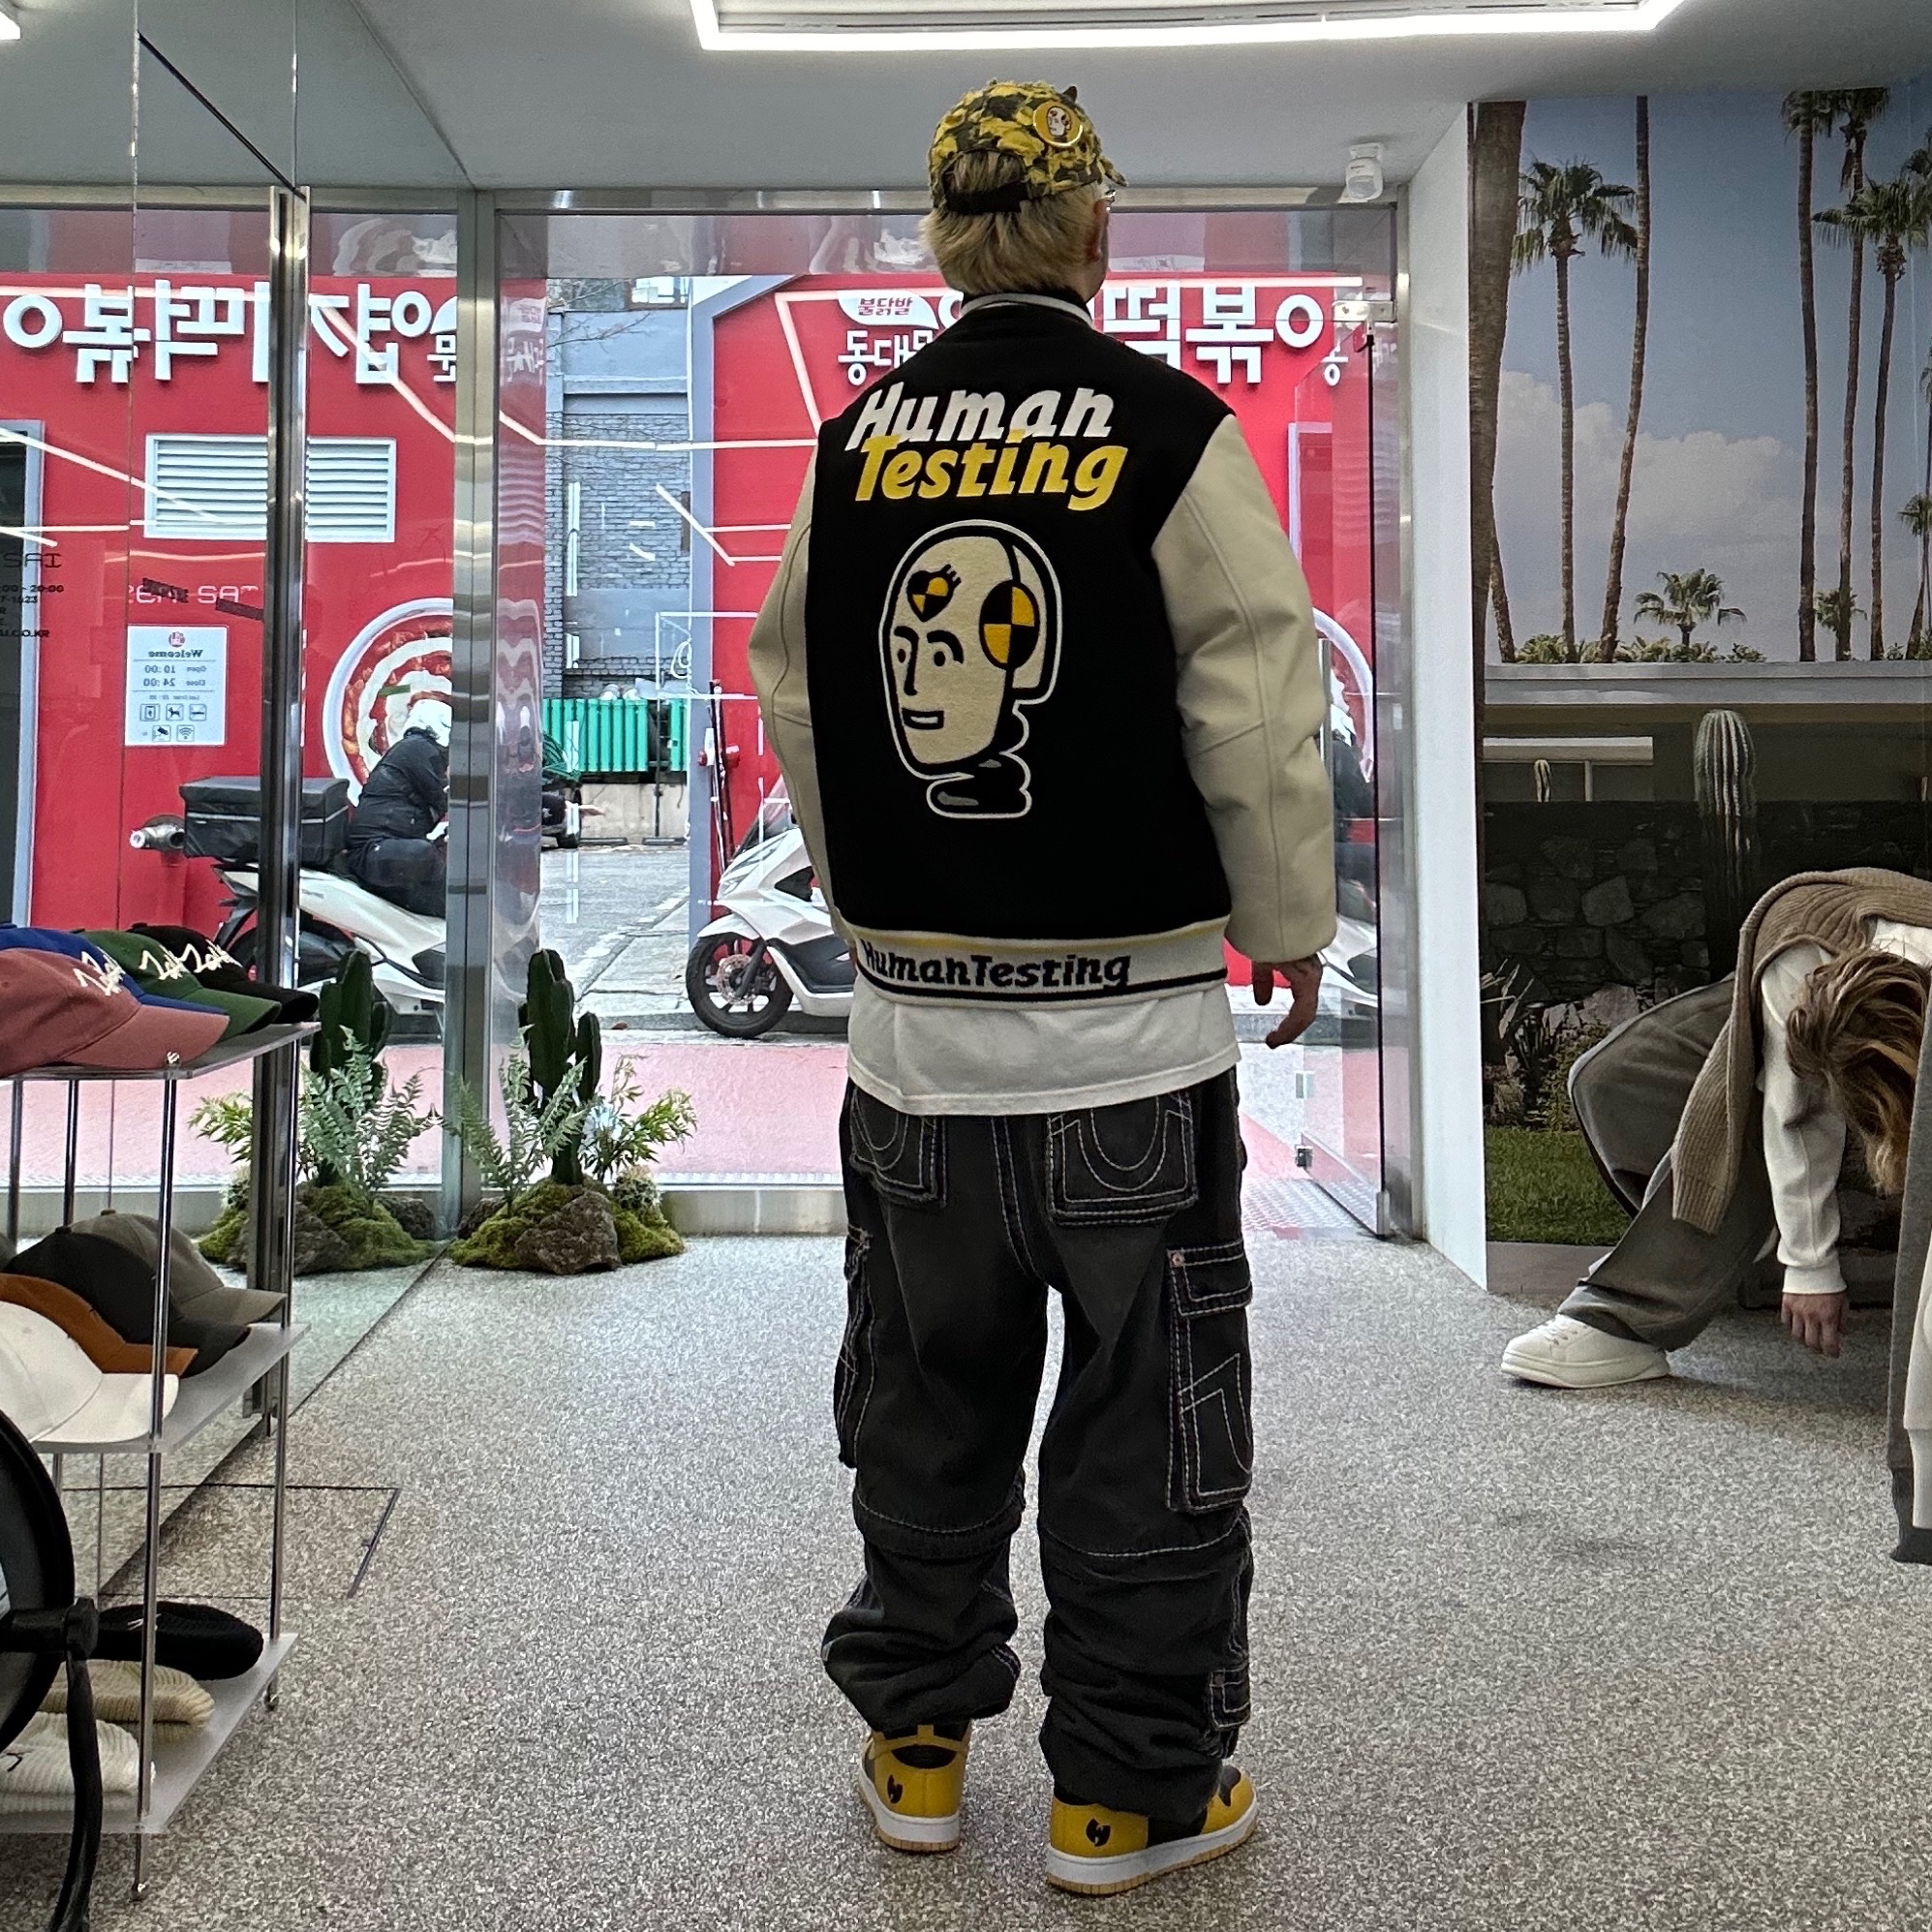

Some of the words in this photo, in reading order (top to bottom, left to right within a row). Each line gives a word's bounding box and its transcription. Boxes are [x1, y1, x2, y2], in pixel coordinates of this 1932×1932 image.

[845, 382, 1115, 452] Human
[855, 429, 1128, 511] Testing
[858, 937, 1131, 991] HumanTesting
